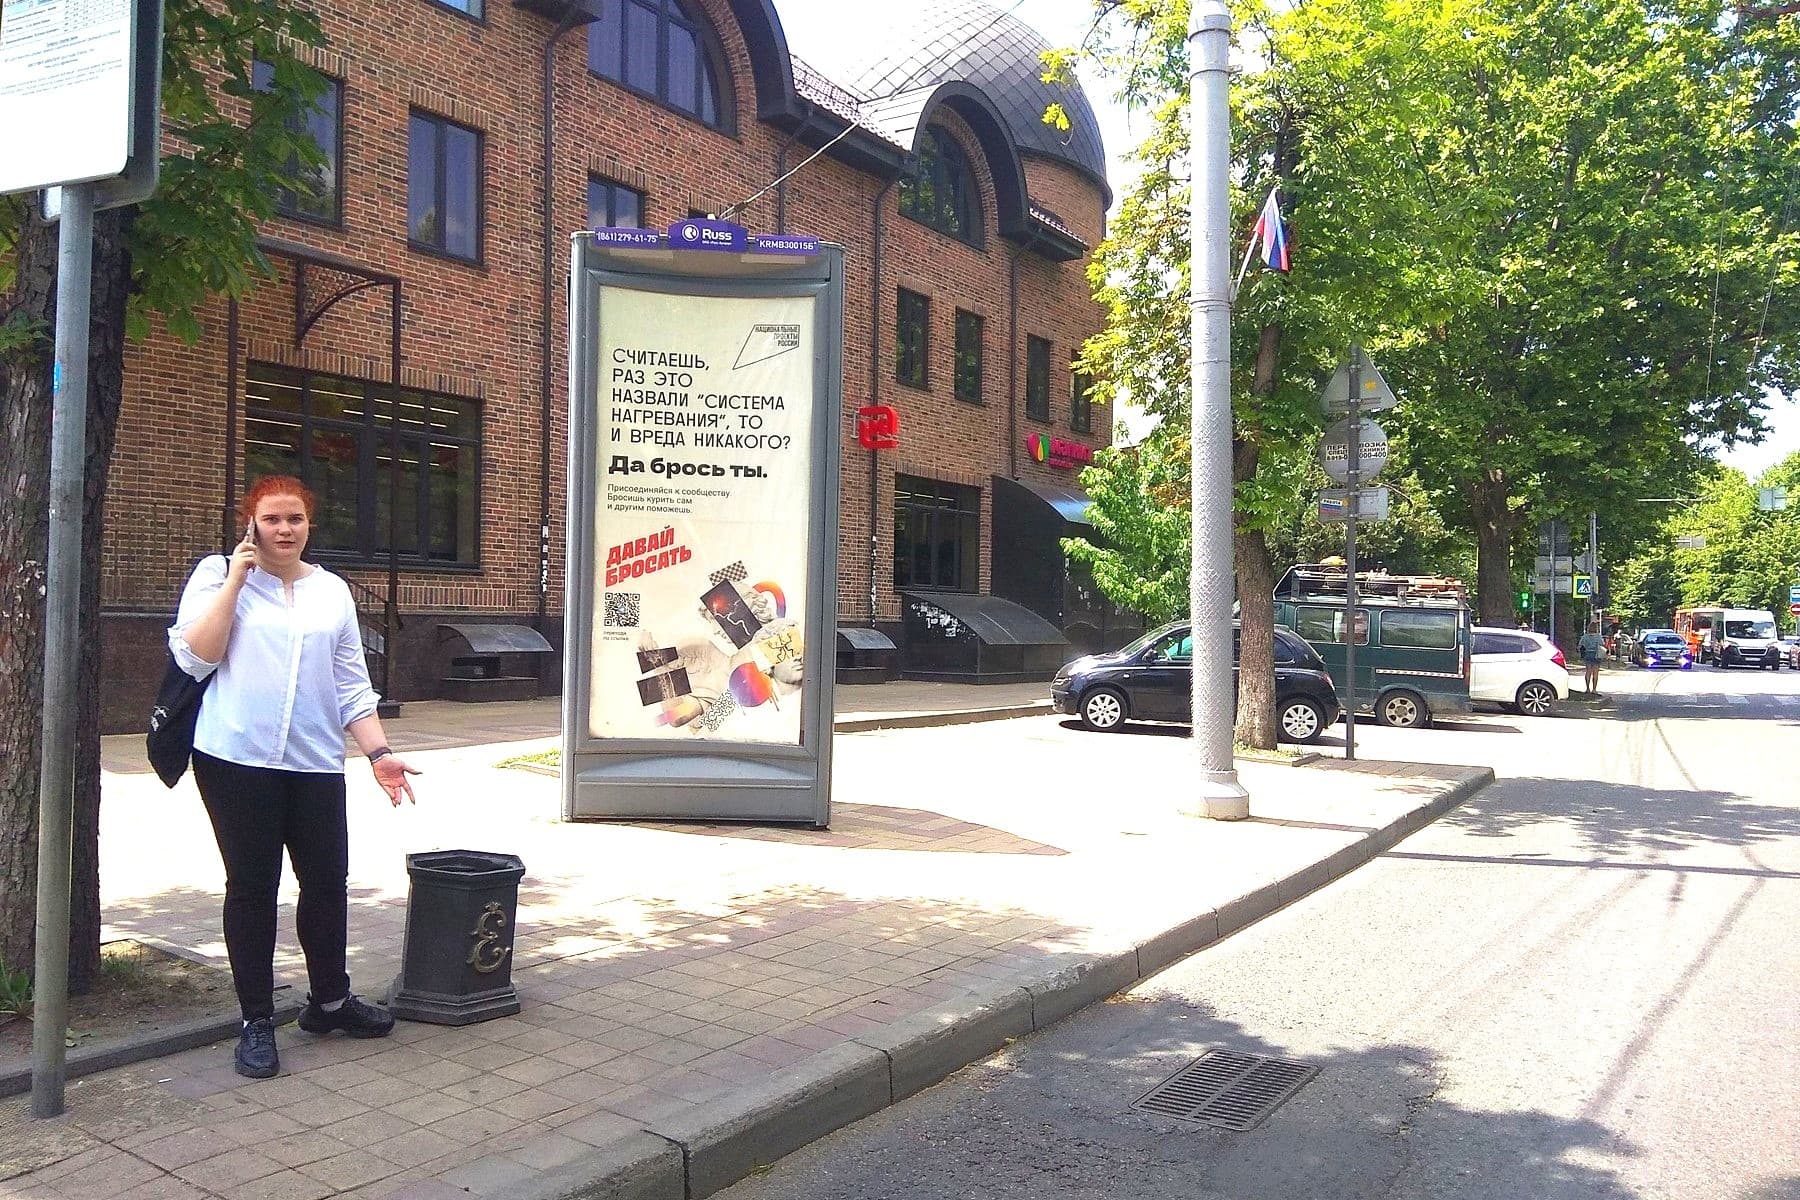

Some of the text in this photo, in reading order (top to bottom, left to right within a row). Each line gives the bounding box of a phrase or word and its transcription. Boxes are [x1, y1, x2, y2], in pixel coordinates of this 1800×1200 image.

[702, 228, 732, 241] Russ
[612, 348, 710, 371] СЧИТАЕШЬ,
[612, 368, 693, 388] РАЗ ЭТО
[612, 388, 689, 407] НАЗВАЛИ
[738, 414, 763, 430] ТО
[611, 427, 791, 450] И ВРЕДА НИКАКОГО?
[608, 455, 768, 479] Да брось ты.
[607, 483, 673, 494] Присоединяйся
[607, 493, 645, 502] Бросишь
[646, 495, 675, 505] курить
[614, 503, 645, 512] другим
[606, 525, 675, 569] ДАВАЙ
[606, 544, 692, 588] БРОСАТЬ
